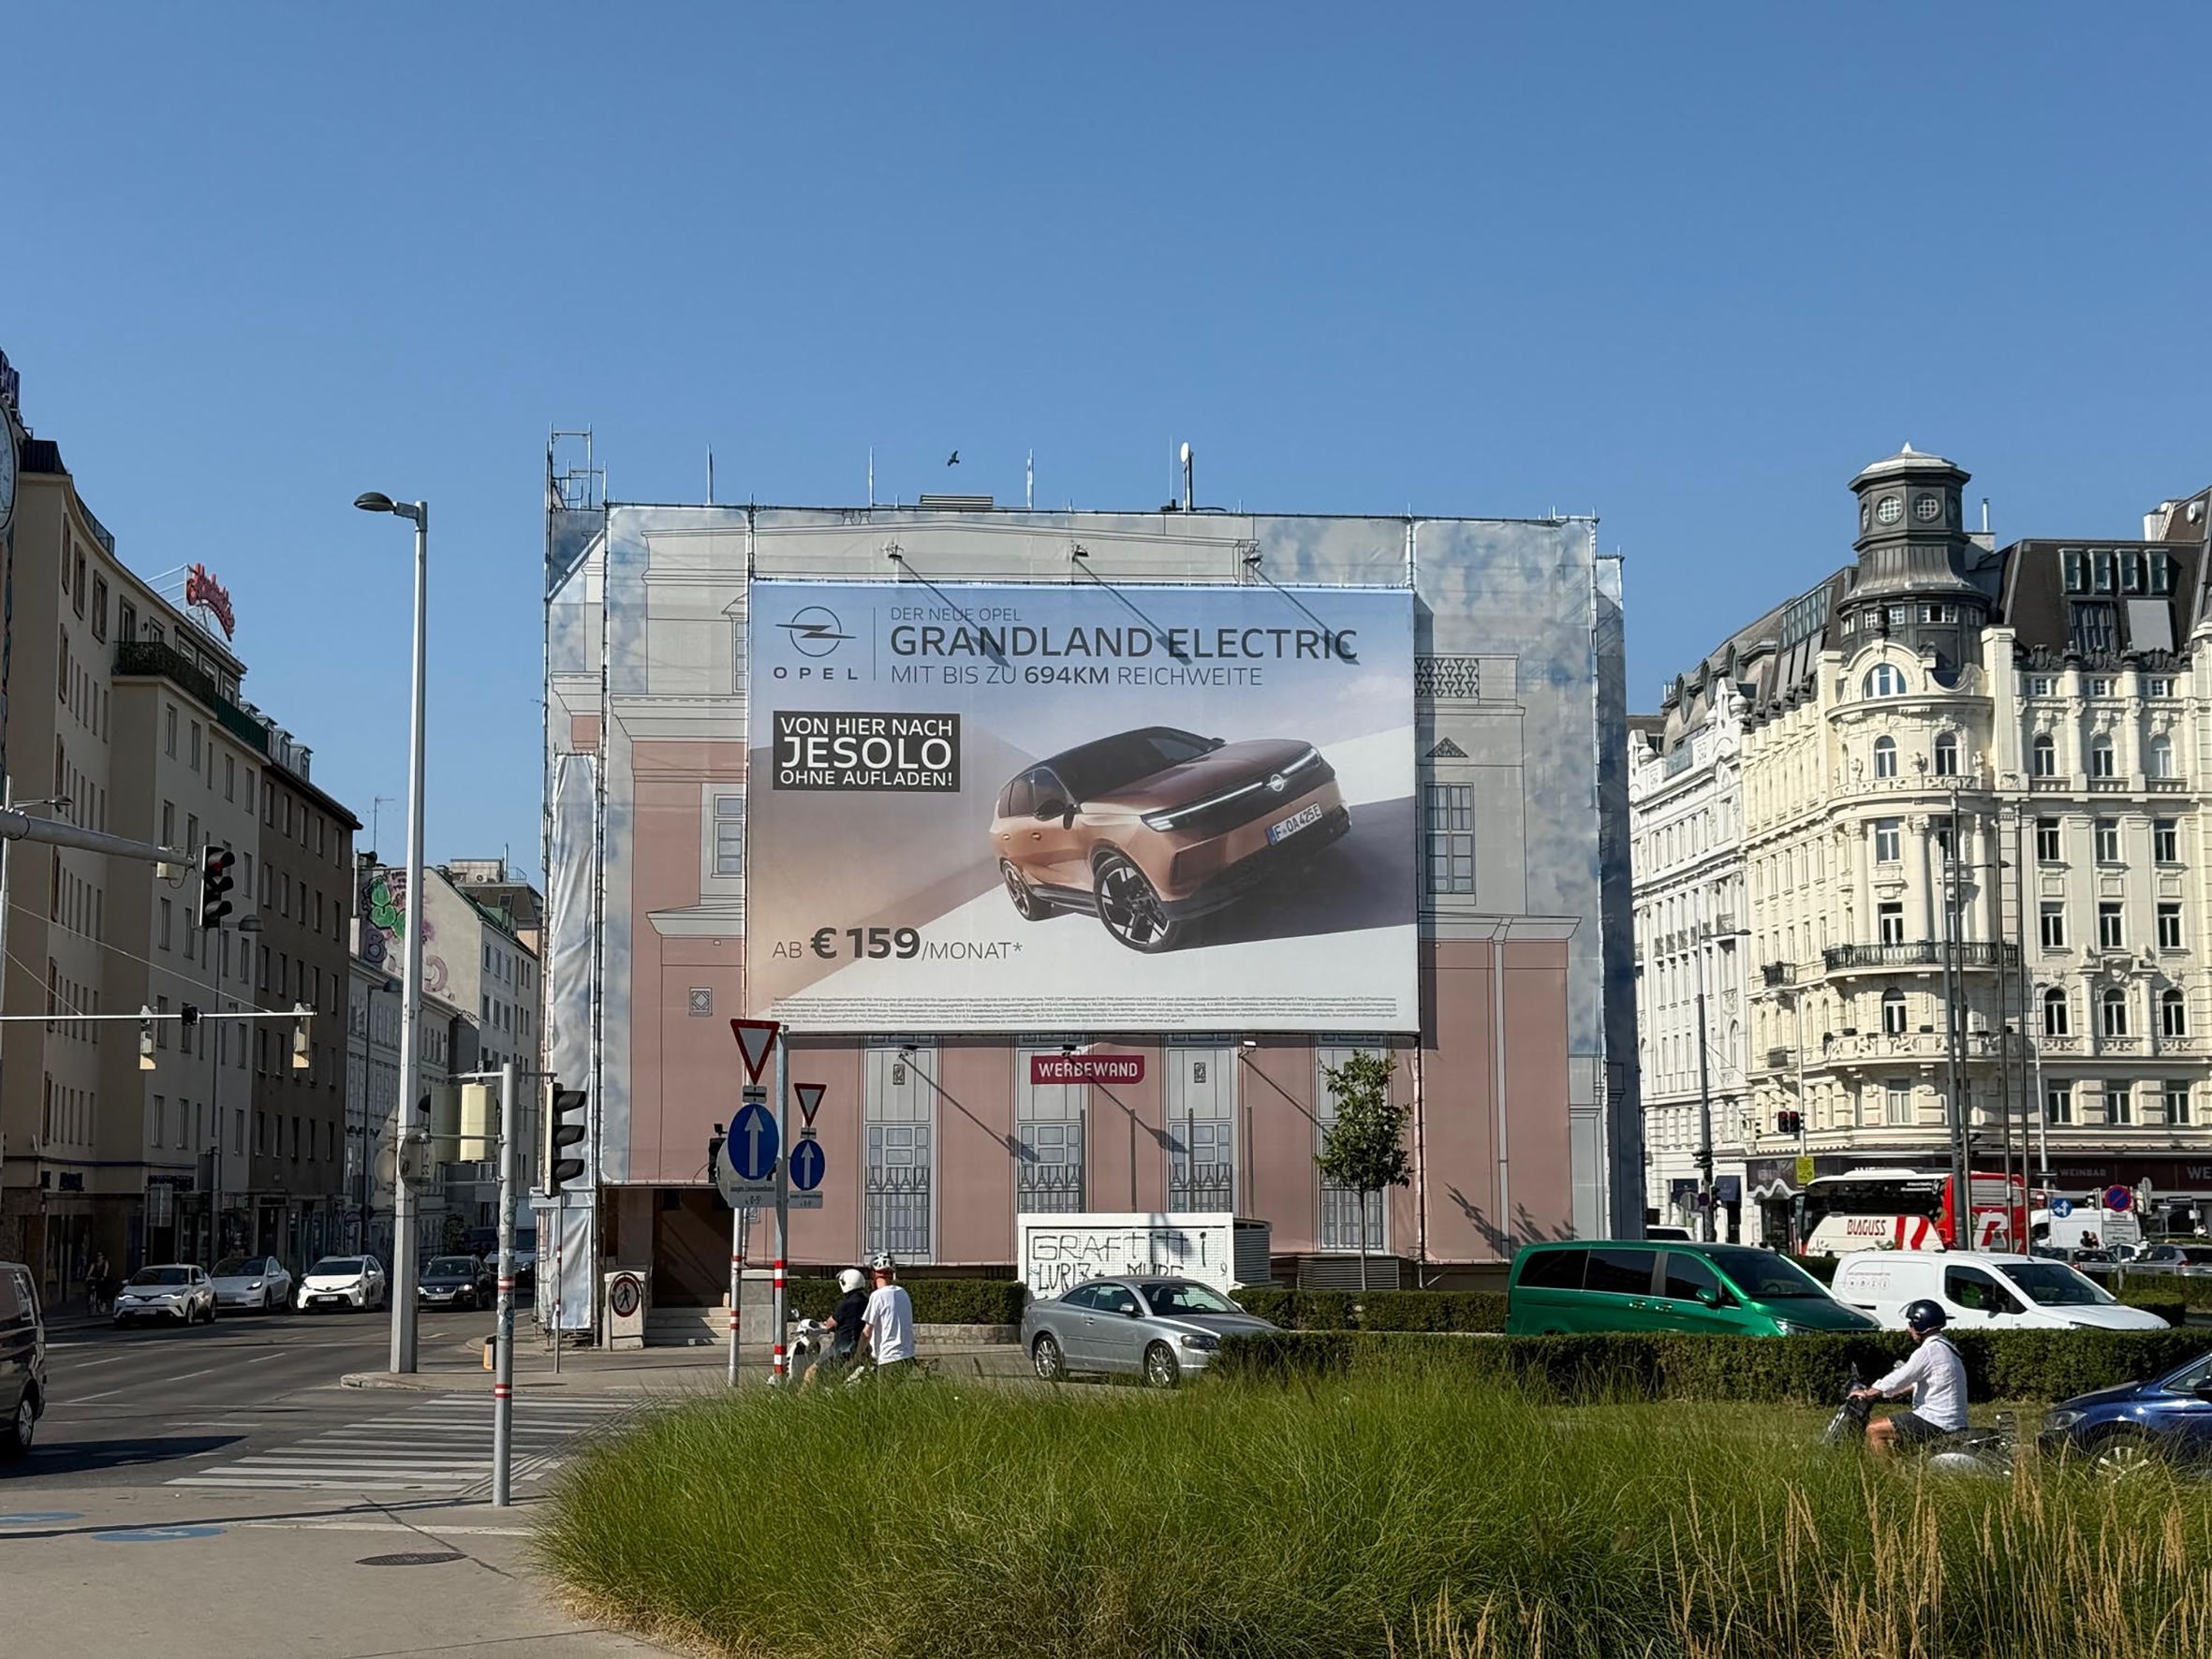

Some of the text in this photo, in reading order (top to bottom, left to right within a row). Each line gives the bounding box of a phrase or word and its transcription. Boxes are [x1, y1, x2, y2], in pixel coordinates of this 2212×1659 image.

[892, 608, 1022, 622] DER NEUE OPEL
[891, 625, 1358, 660] GRANDLAND ELECTRIC
[774, 667, 858, 681] OPEL
[892, 665, 1262, 686] MIT BIS ZU 694KM REICHWEITE
[780, 717, 952, 737] VON HIER NACH
[781, 736, 951, 770] JESOLO
[780, 770, 952, 786] OHNE AUFLADEN!
[773, 941, 803, 959] AB
[1039, 1062, 1138, 1078] WERBEWAND
[2060, 1167, 2107, 1177] WEINBAR
[1847, 1219, 1886, 1236] BLAGUSS
